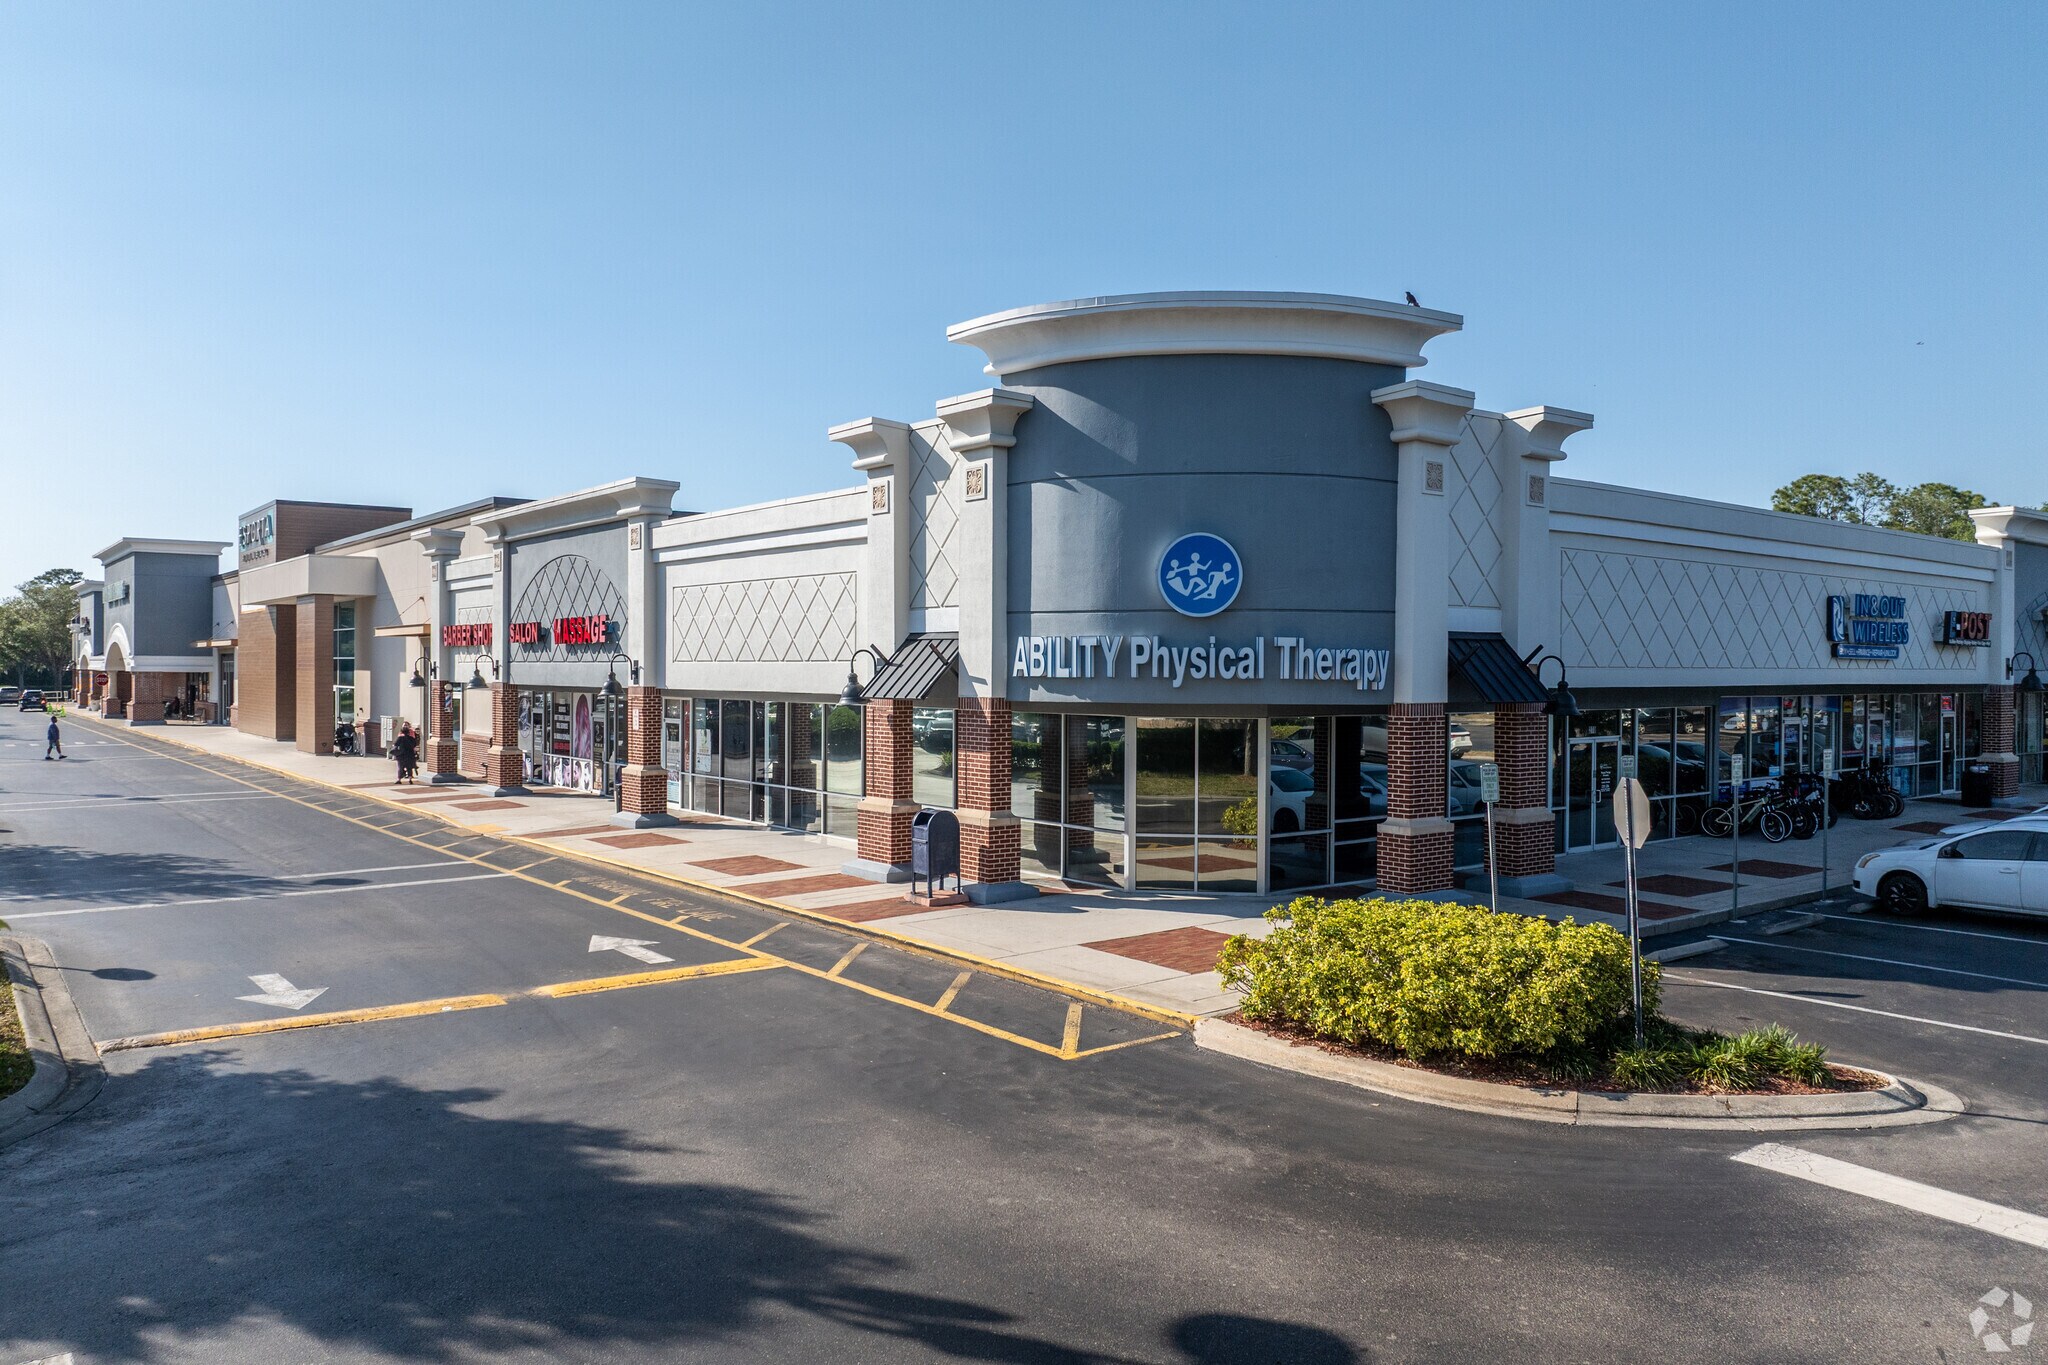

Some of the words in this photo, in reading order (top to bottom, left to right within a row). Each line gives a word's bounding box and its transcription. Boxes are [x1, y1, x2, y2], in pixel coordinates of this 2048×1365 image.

[443, 625, 472, 647] BARBER
[509, 622, 539, 644] SALON
[554, 615, 607, 645] MASSAGE
[1852, 620, 1909, 644] WIRELESS
[1012, 635, 1123, 678] ABILITY
[1130, 635, 1264, 688] Physical
[1274, 636, 1390, 690] Therapy
